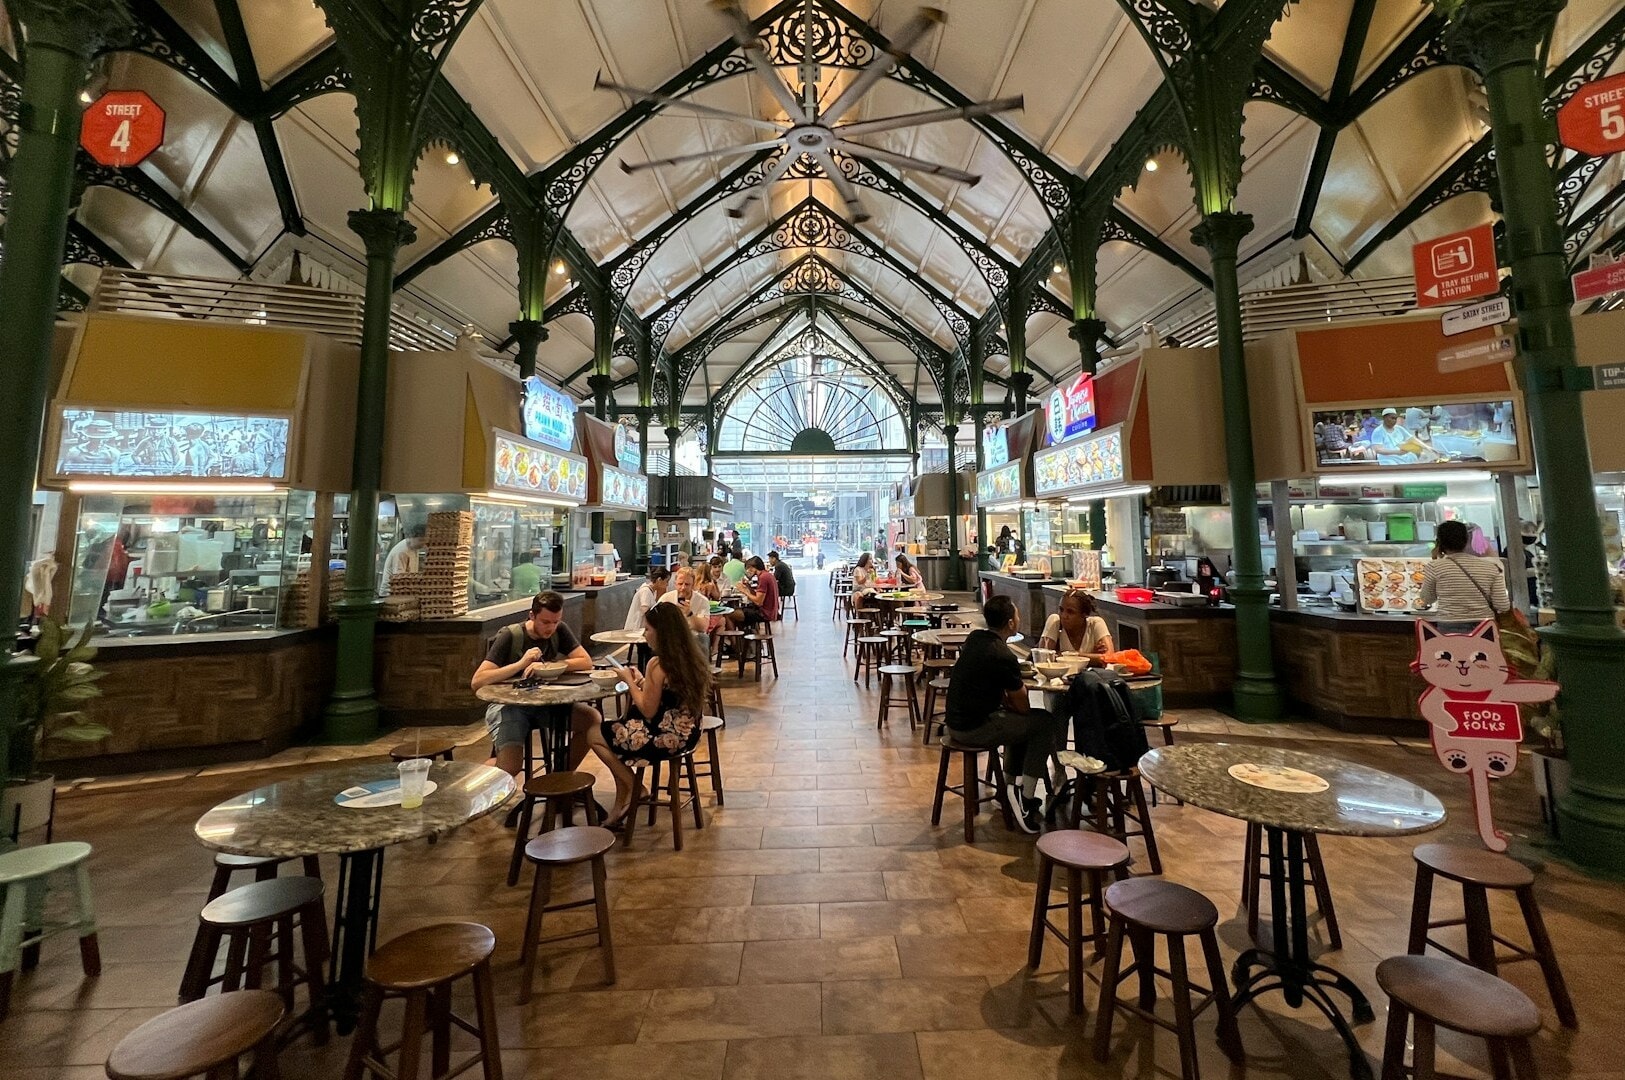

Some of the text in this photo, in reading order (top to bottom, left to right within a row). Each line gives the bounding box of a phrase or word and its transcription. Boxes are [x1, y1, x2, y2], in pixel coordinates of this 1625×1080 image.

[105, 104, 142, 116] STREET
[1600, 104, 1625, 140] 5
[110, 119, 131, 153] 4
[1441, 271, 1490, 290] TRAY RETURN
[1441, 284, 1472, 298] STATION
[1462, 301, 1505, 320] SATAY STREET
[1463, 710, 1501, 721] FOOD
[1463, 720, 1505, 731] FOLKS
